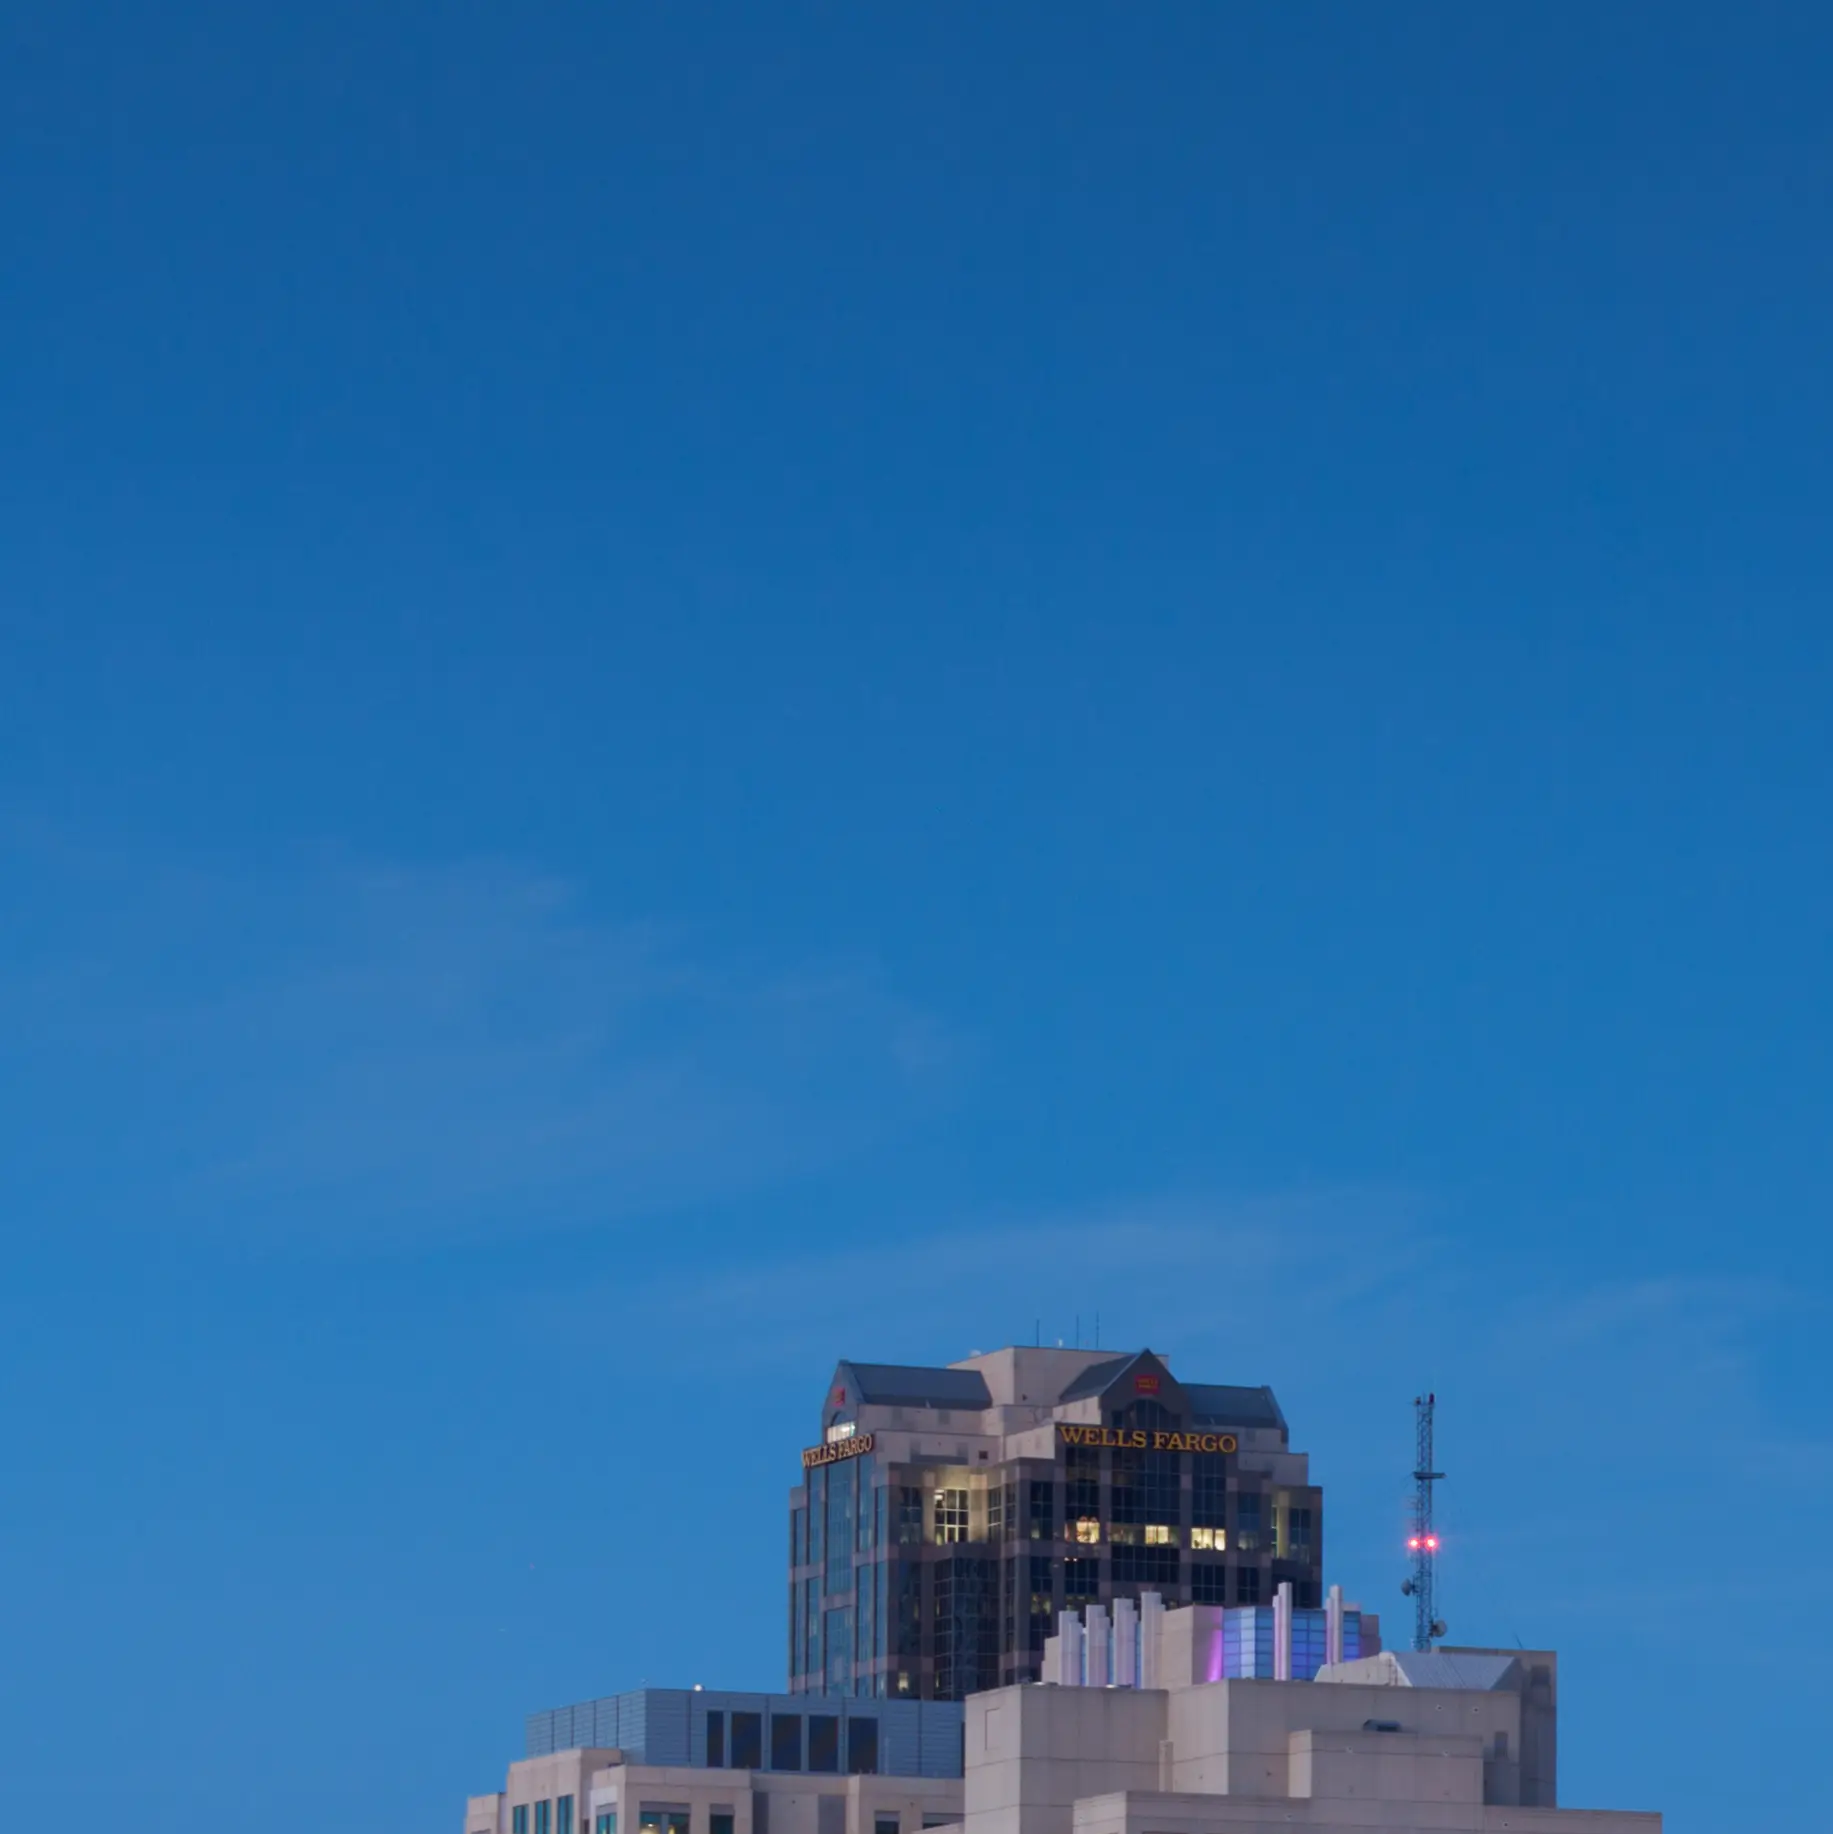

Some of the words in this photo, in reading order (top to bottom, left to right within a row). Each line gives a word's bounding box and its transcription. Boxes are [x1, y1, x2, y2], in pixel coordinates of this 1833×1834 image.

[802, 1444, 837, 1468] WELLS
[838, 1433, 873, 1459] FARGO
[1059, 1425, 1147, 1448] WELLS
[1153, 1431, 1237, 1454] FARGO
